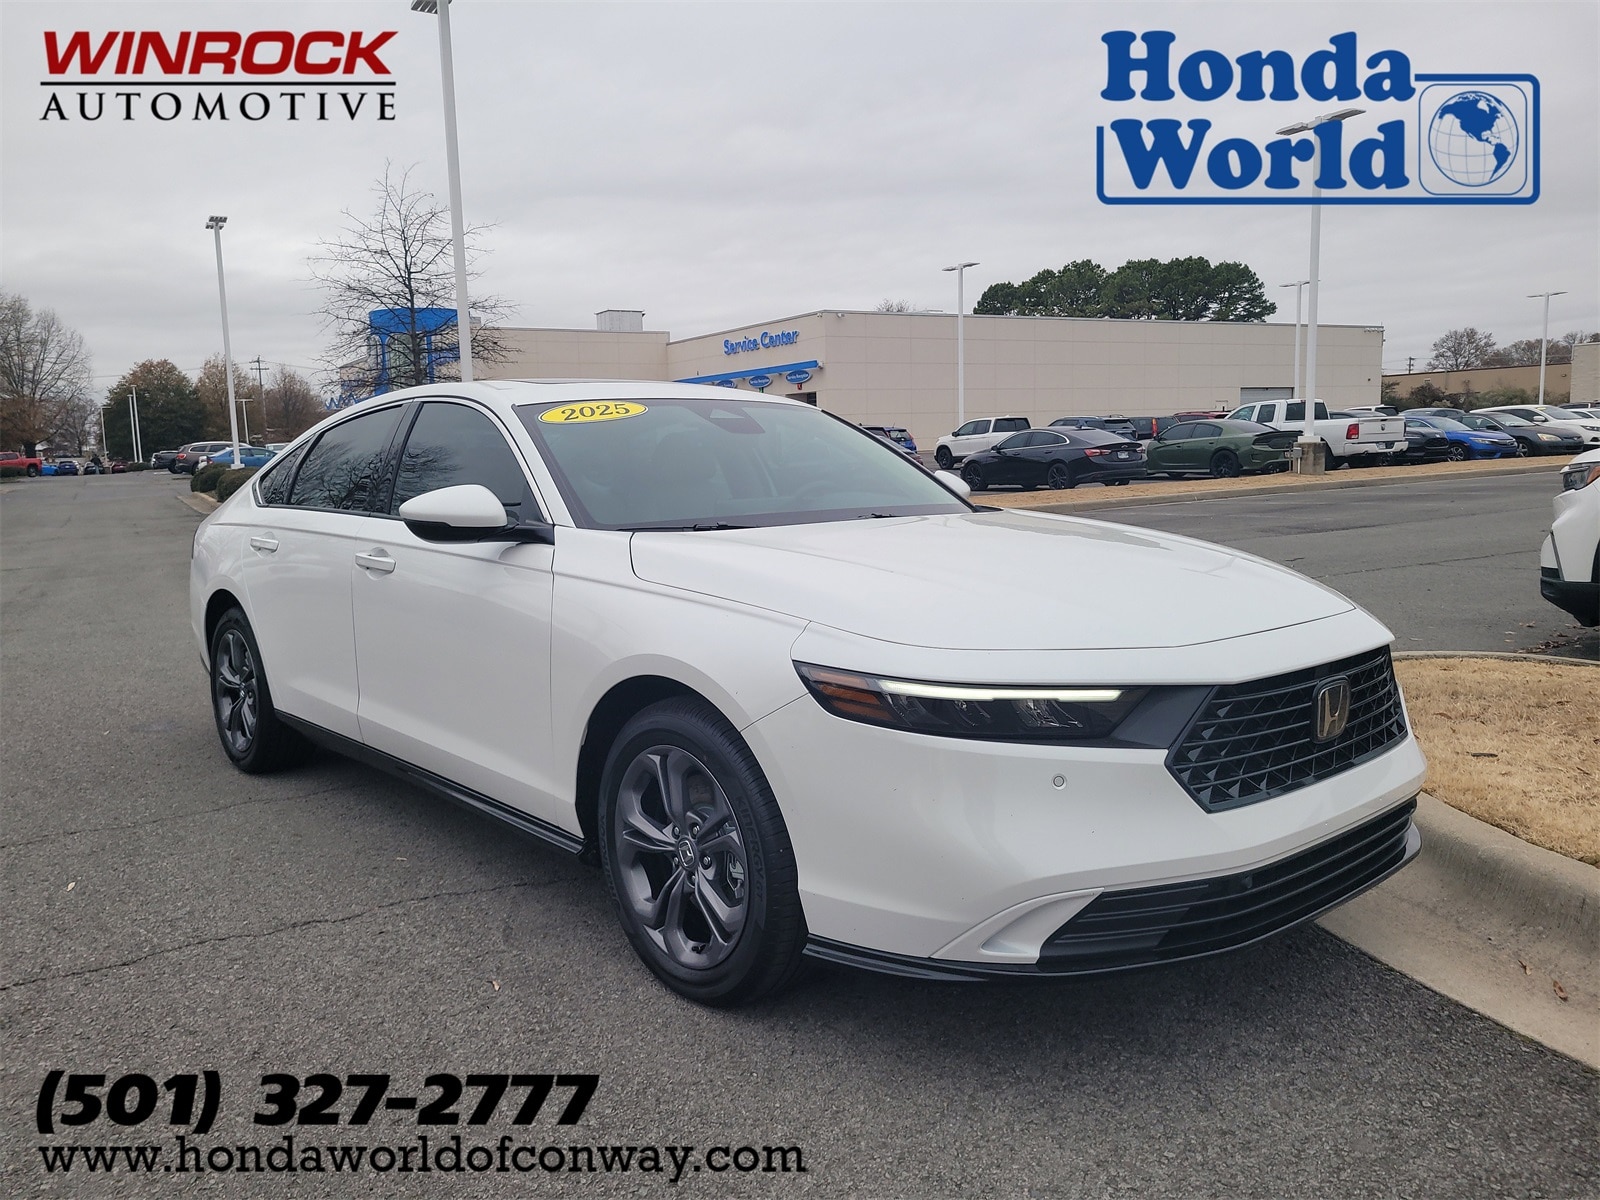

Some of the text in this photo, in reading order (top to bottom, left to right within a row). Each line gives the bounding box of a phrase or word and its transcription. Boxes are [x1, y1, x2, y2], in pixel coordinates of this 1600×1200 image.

[723, 330, 799, 355] Service Center
[561, 403, 631, 421] 2025
[735, 795, 765, 880] KINERGY
